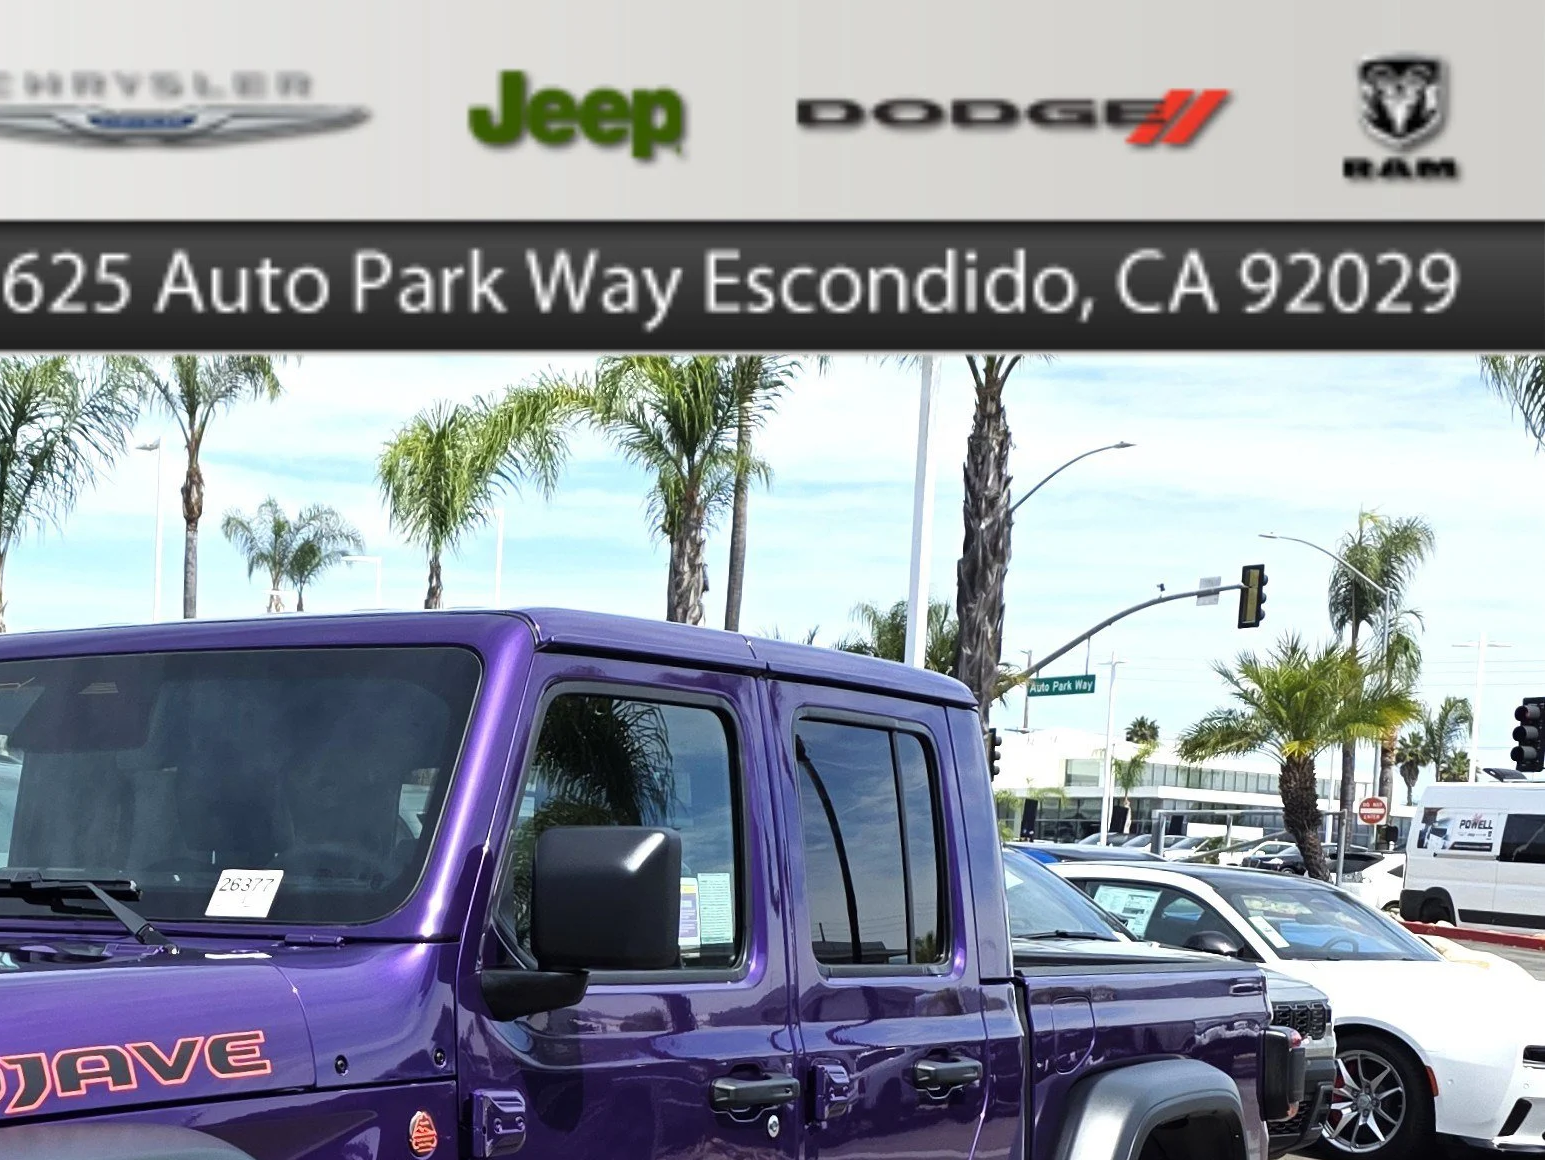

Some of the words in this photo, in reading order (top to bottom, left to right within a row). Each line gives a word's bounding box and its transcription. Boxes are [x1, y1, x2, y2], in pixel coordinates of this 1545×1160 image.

[1029, 682, 1051, 693] Auto
[1052, 680, 1073, 692] Park
[1075, 679, 1094, 691] Way
[1458, 819, 1493, 830] POWELL
[218, 877, 275, 892] 26377
